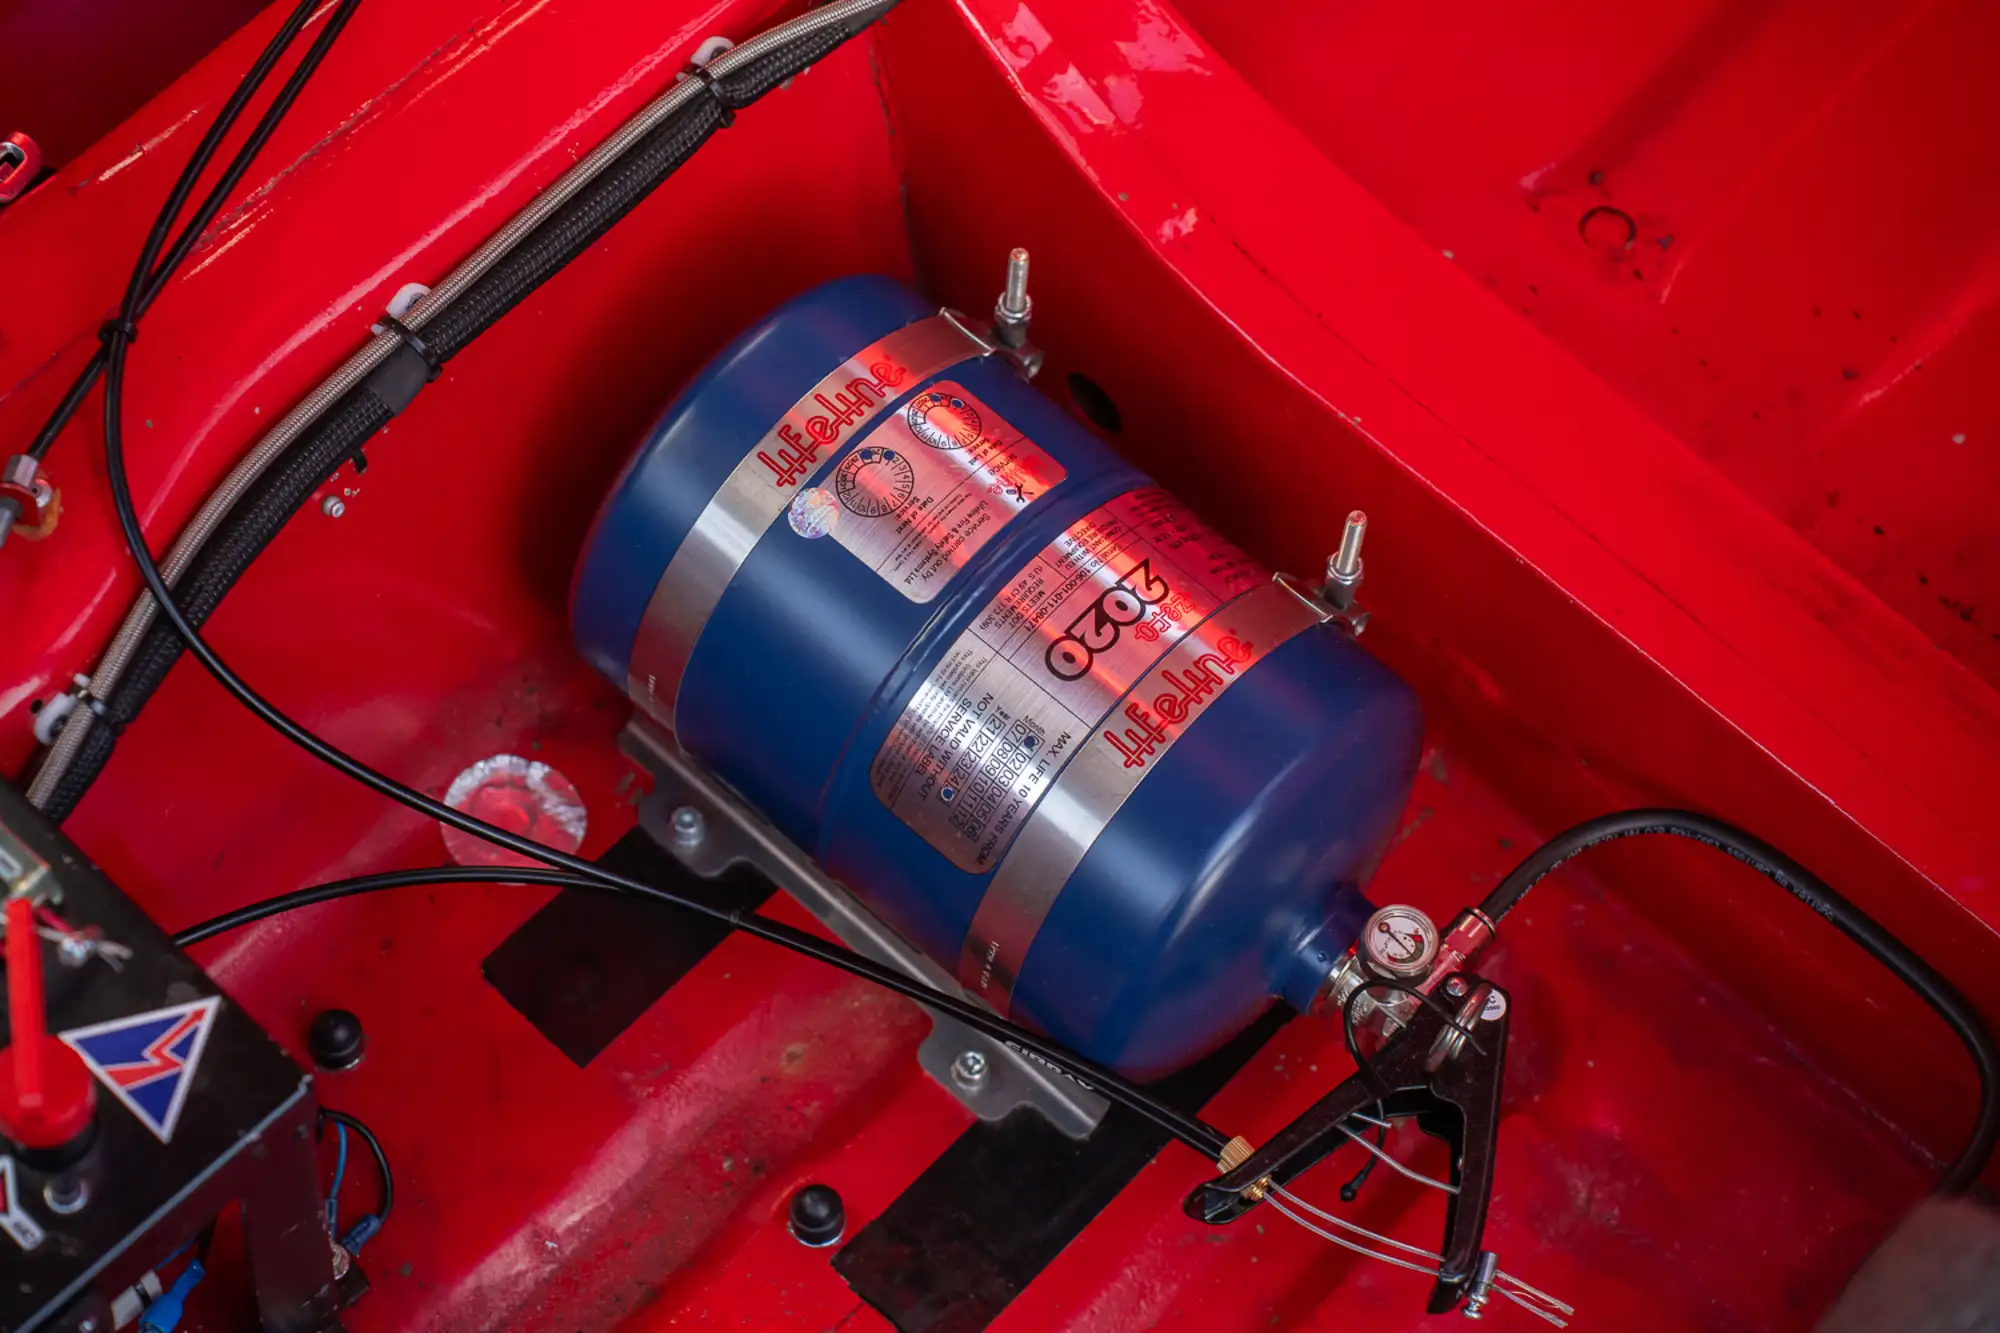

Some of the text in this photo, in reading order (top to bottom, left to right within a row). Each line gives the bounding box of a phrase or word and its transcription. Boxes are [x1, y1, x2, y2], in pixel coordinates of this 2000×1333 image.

[898, 463, 907, 472] 3
[902, 473, 909, 481] 4
[897, 491, 905, 499] 6
[901, 482, 910, 490] 5
[891, 500, 898, 508] 7
[894, 494, 933, 535] Date of Next
[962, 512, 991, 538] Service
[1098, 541, 1120, 559] Serial
[928, 558, 943, 572] out
[1063, 559, 1076, 571] EU
[993, 576, 1044, 629] REQUIREMENTS
[1006, 588, 1045, 628] MEETS DOT
[1044, 557, 1169, 681] 2020
[1133, 591, 1194, 644] zero
[969, 691, 994, 718] NOT
[934, 696, 973, 745] SERVICE
[946, 717, 975, 751] VALID
[1043, 730, 1072, 759] MAX.
[913, 744, 940, 778] LABEL
[949, 718, 1002, 786] 21 22 23 24
[1007, 751, 1027, 770] 02
[915, 748, 953, 800] WITHOUT
[950, 722, 1027, 826] 07 08 09 10 11 12
[995, 768, 1014, 787] 03
[1026, 757, 1050, 783] LIFE
[984, 784, 1003, 804] 04
[1016, 783, 1032, 798] 10
[973, 801, 993, 821] 05
[992, 796, 1023, 834] YEARS
